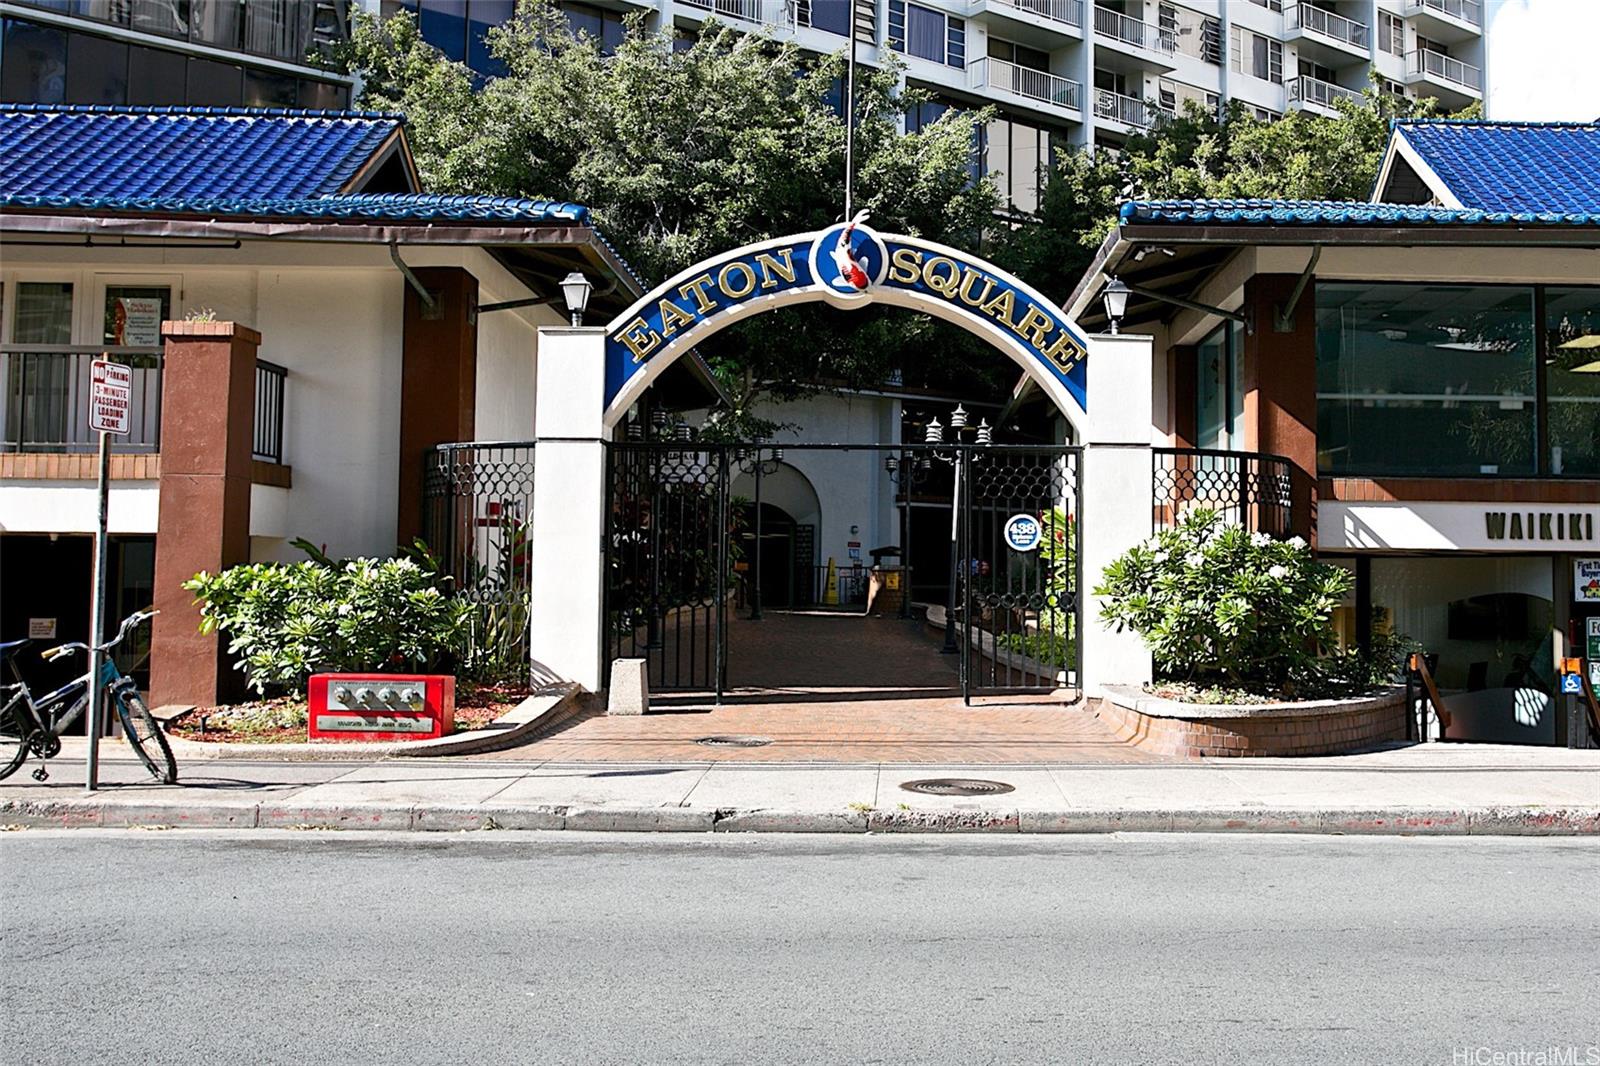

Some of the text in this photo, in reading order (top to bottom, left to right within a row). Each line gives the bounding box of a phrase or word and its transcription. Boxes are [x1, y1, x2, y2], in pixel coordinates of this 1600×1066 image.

[614, 248, 1086, 375] EATON SQUARE
[94, 365, 129, 382] NO PARKING
[95, 385, 127, 399] 3-MINUTE
[94, 396, 128, 409] PASSENGER
[97, 406, 124, 419] LOADING
[101, 417, 120, 429] ZONE
[1485, 512, 1593, 540] WAIKIKI
[1577, 561, 1592, 570] First
